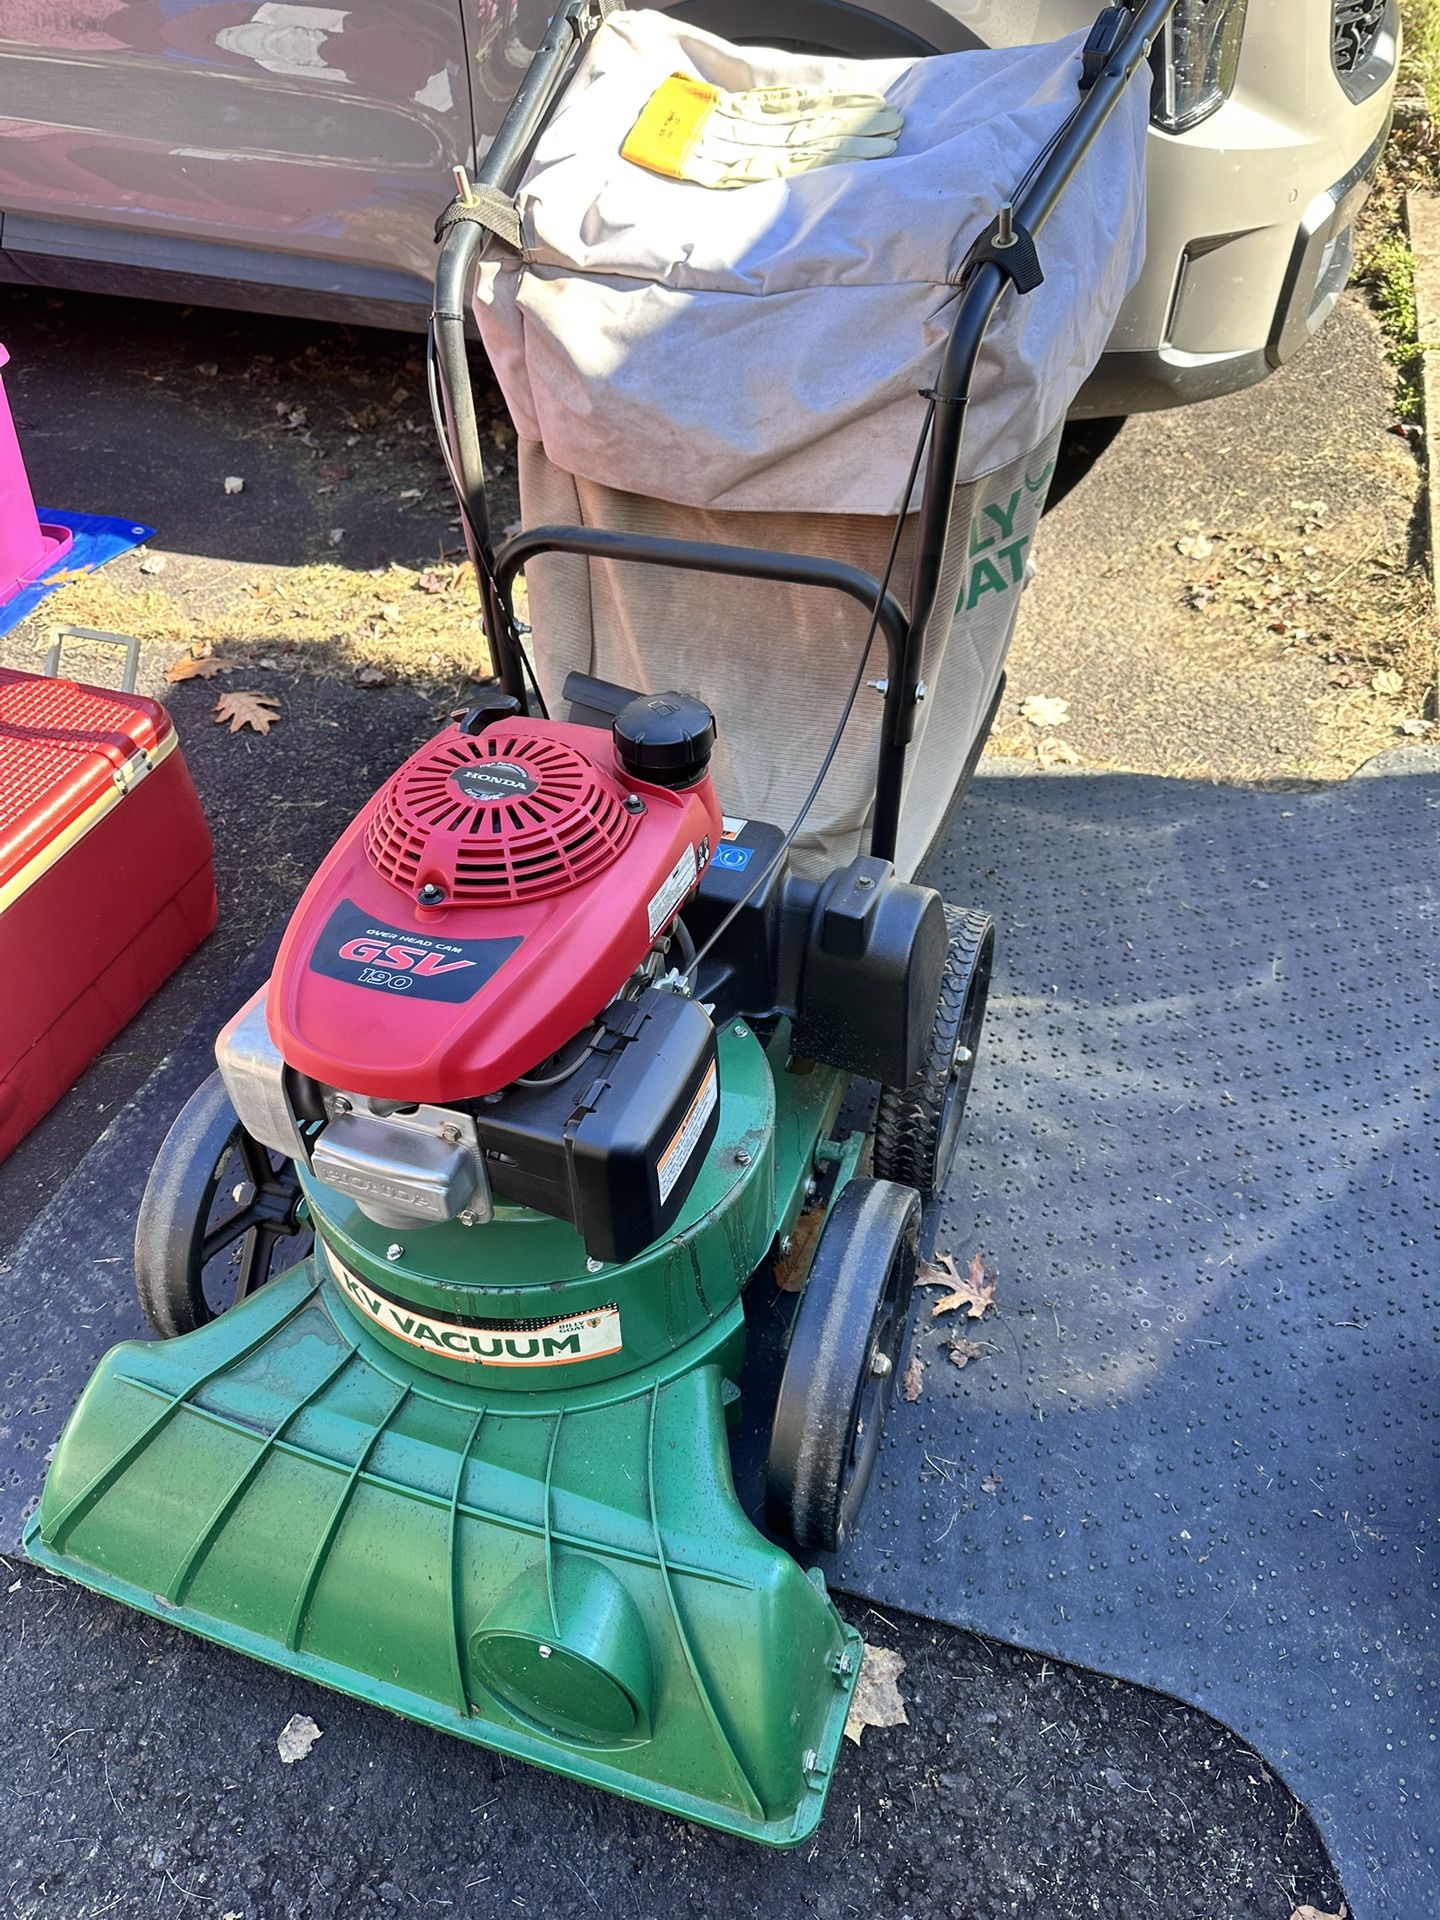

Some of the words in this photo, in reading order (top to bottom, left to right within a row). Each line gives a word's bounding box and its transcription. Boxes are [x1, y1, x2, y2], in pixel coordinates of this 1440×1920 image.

[463, 771, 527, 790] HONDA
[366, 929, 398, 940] OVER
[399, 935, 433, 947] HEAD
[435, 943, 464, 954] CAM
[338, 937, 478, 977] GSV
[357, 967, 414, 990] 190
[321, 1166, 440, 1212] HONDA
[342, 1271, 382, 1316] KV
[388, 1309, 581, 1359] VACUUM
[559, 1320, 585, 1330] BILLY
[559, 1325, 585, 1333] GOAT
